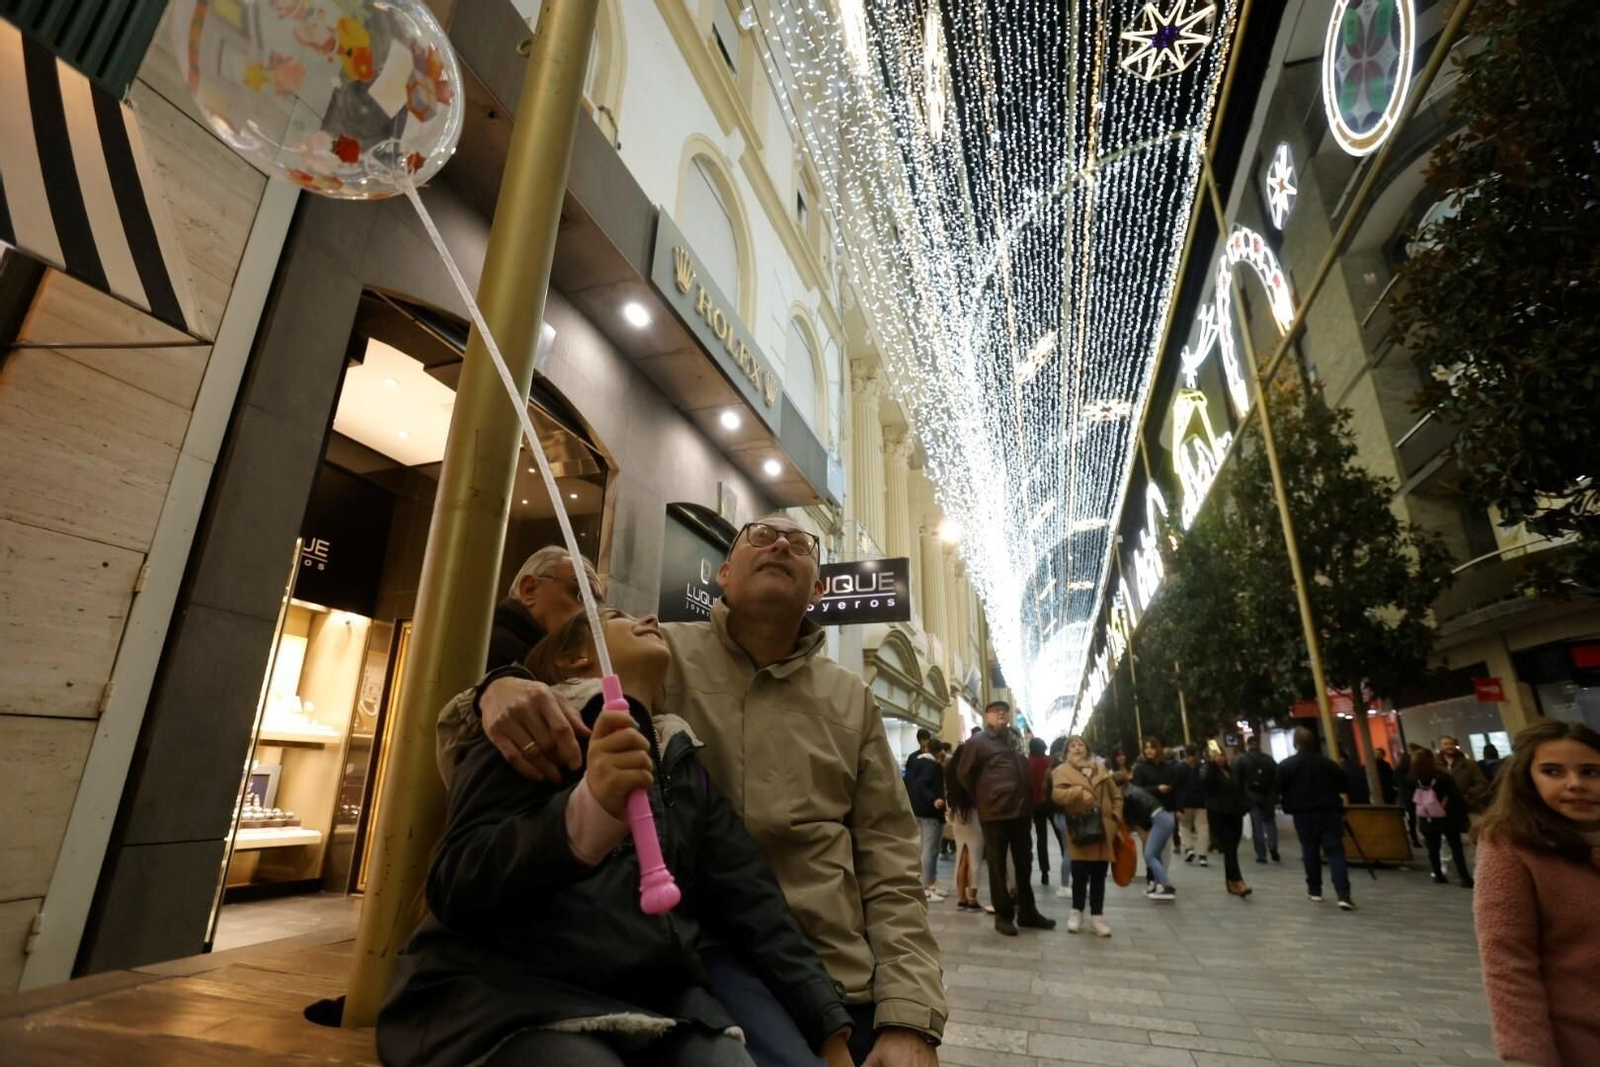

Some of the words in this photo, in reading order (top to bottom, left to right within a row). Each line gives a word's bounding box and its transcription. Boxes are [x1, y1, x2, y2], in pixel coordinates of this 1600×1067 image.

[696, 283, 762, 392] ROLEX
[823, 571, 895, 595] QUE
[806, 598, 896, 613] oyeros
